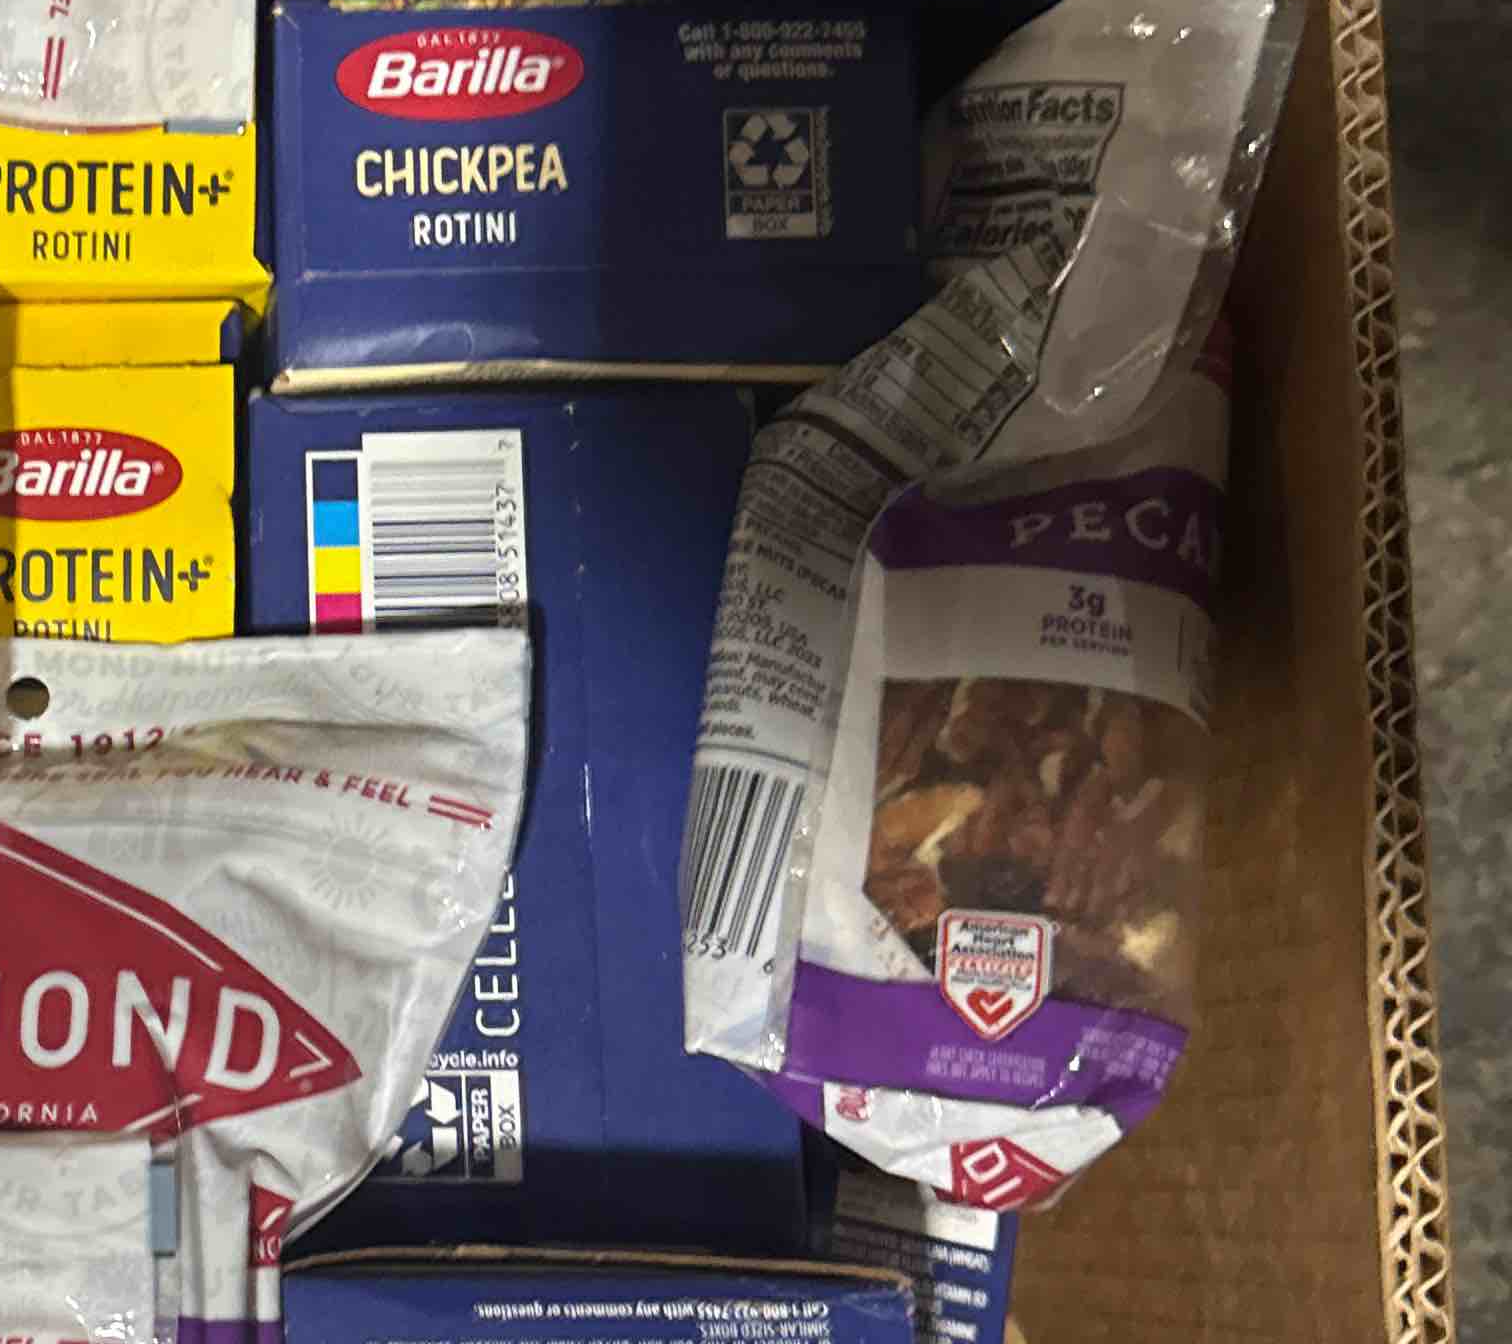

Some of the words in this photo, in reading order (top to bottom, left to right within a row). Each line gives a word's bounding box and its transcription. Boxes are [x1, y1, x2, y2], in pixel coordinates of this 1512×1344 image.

[368, 46, 552, 98] Barilla
[1028, 87, 1114, 123] Facts
[356, 144, 569, 197] CHICKPEA
[33, 230, 132, 263] ROTINI
[411, 212, 517, 247] ROTINI
[1009, 498, 1208, 569] PECA
[1067, 585, 1107, 617] 3g
[1041, 613, 1132, 641] PROTEIN
[471, 1087, 490, 1162] PAPER
[498, 1104, 517, 1151] BOX
